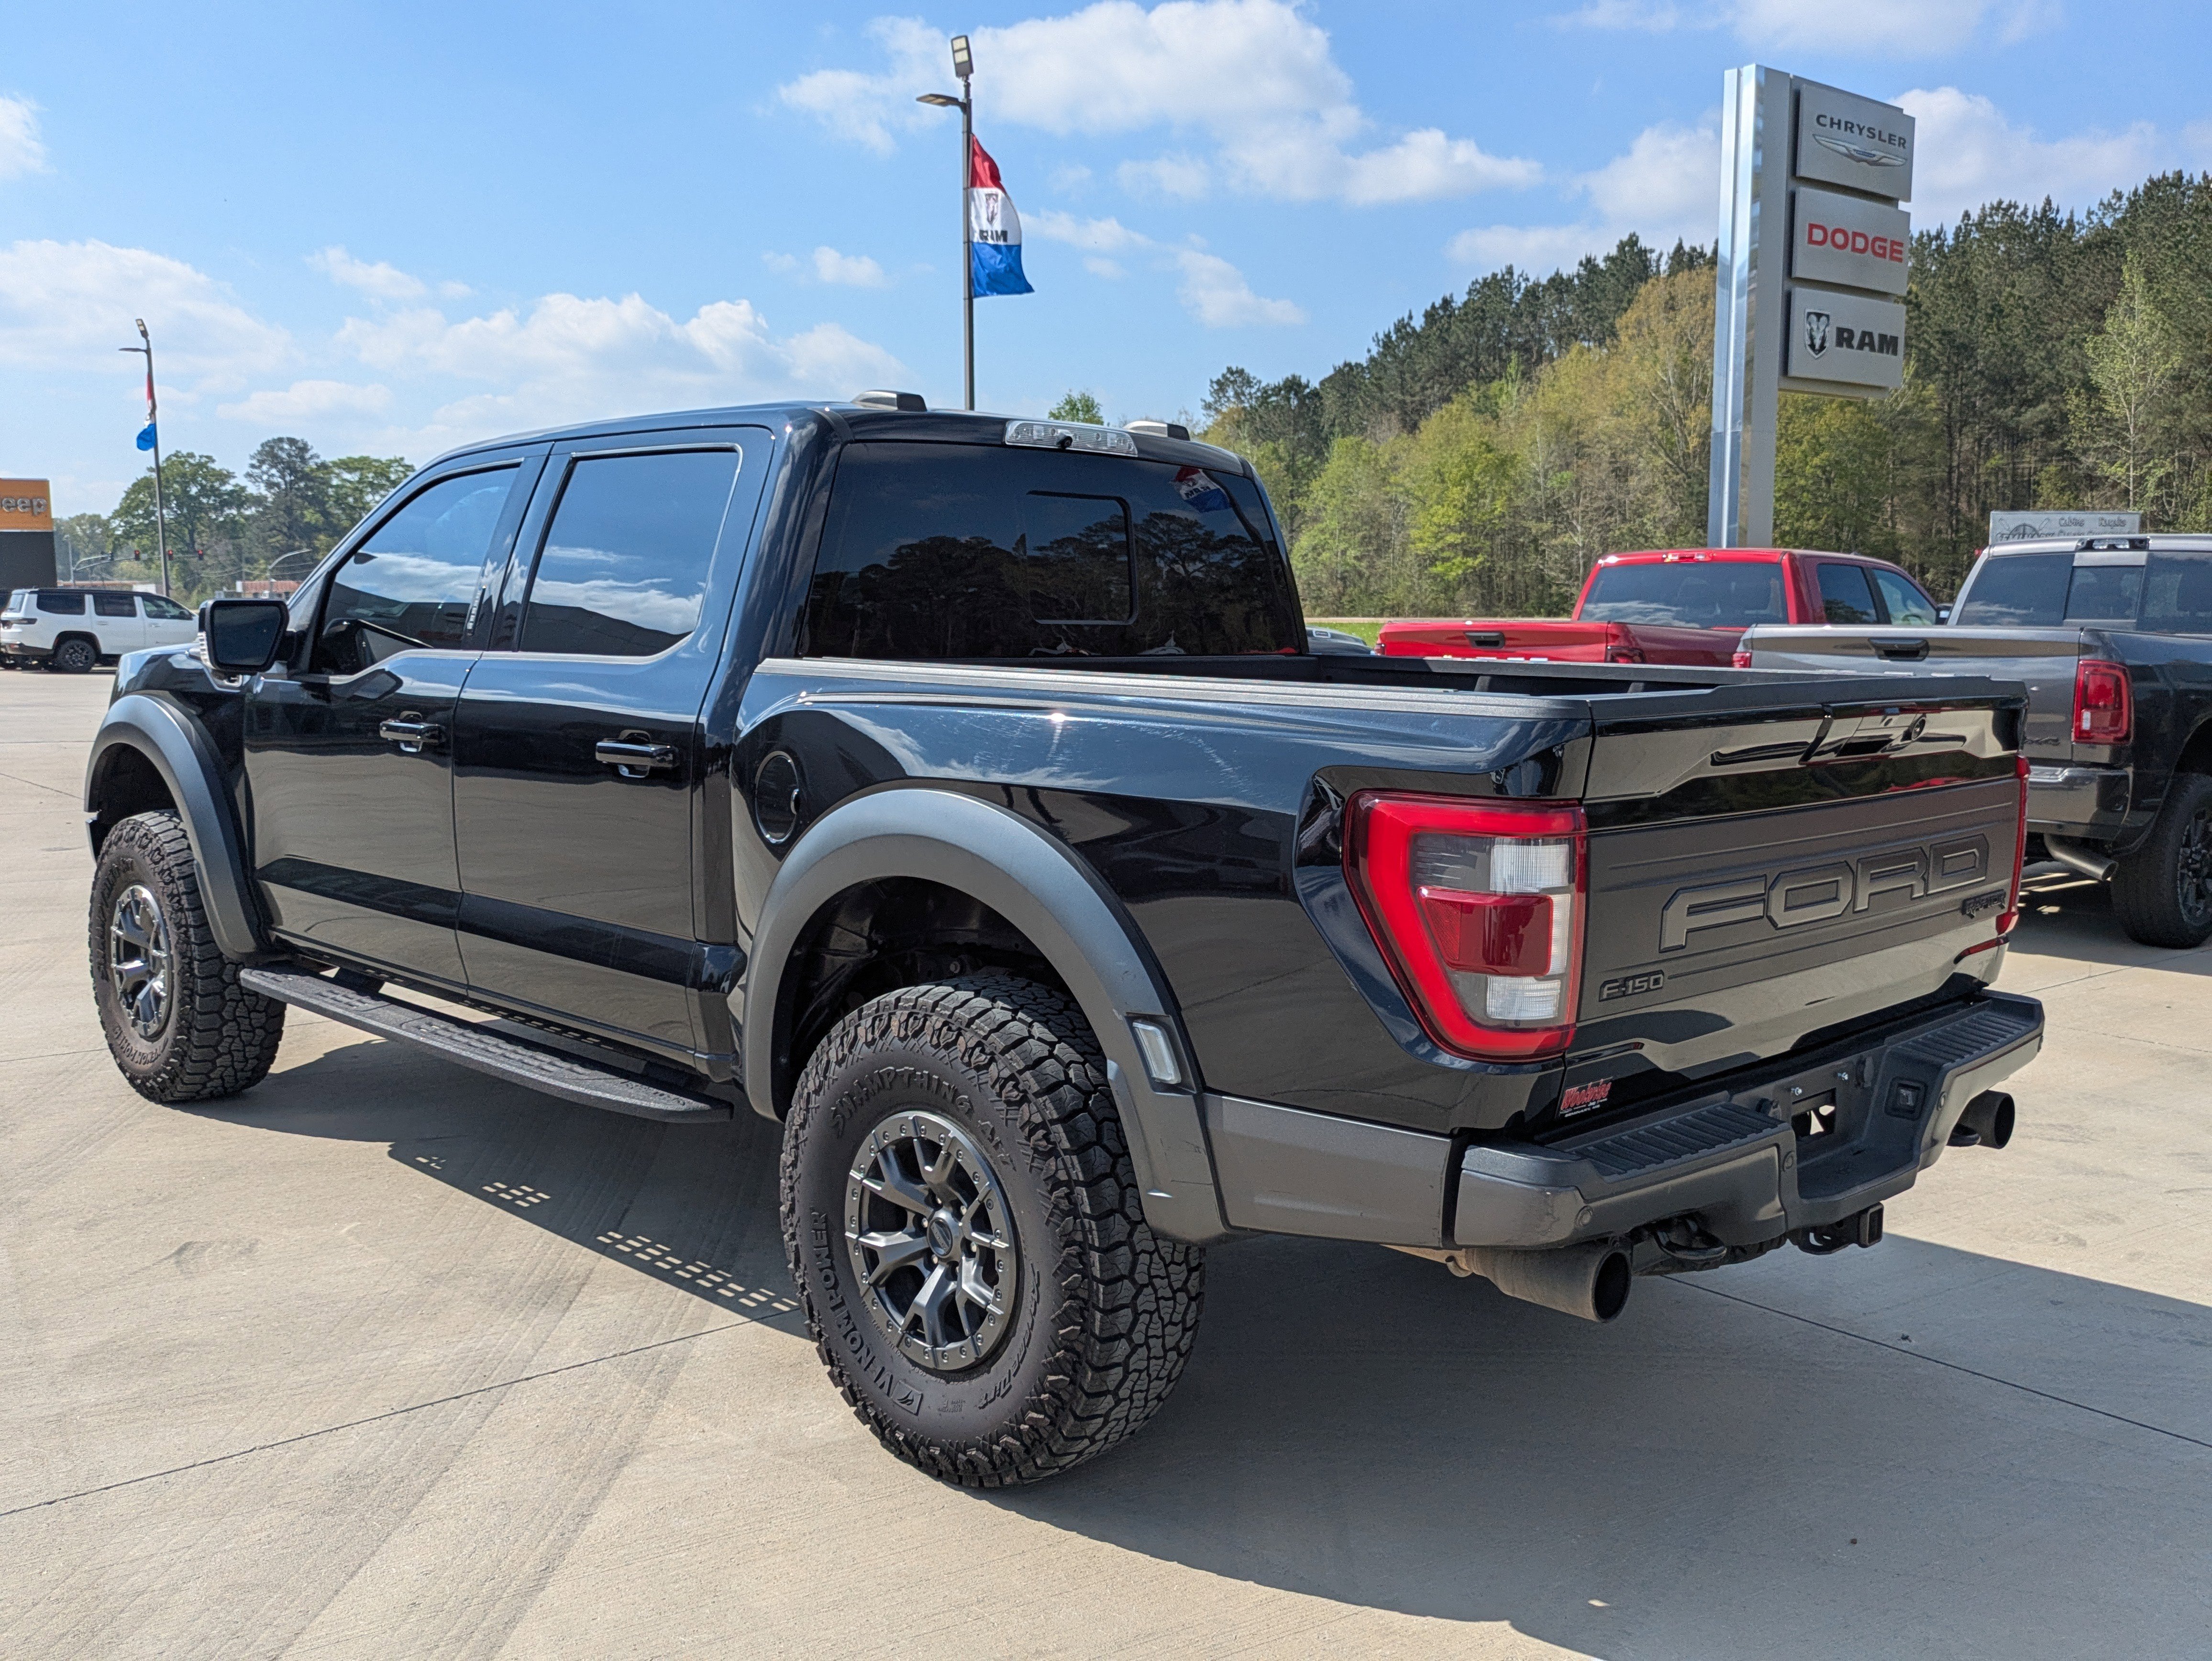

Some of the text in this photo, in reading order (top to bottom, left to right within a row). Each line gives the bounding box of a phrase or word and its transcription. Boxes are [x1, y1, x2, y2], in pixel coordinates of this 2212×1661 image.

[1816, 114, 1907, 149] CHRYSLER
[1807, 223, 1904, 263] DODGE
[1835, 326, 1899, 357] RAM
[1, 498, 48, 517] eep
[1659, 833, 1989, 953] FORD
[1603, 974, 1663, 998] F-150
